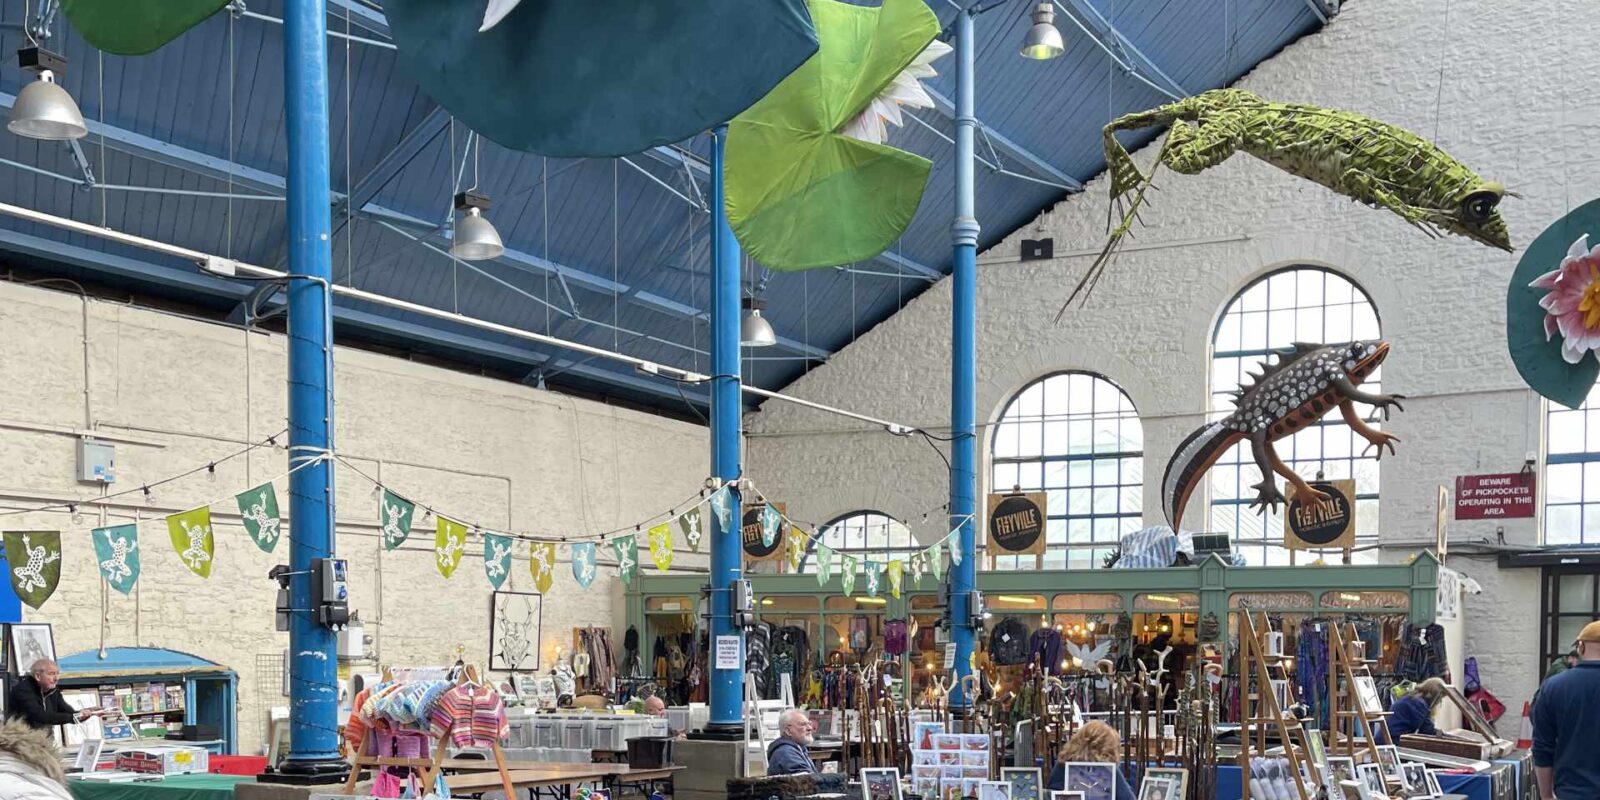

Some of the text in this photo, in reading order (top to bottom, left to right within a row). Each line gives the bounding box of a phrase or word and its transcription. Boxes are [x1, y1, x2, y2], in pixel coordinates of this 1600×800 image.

[1479, 478, 1512, 486] BEWARE
[1462, 487, 1529, 497] OF PICKPOCKETS
[1458, 496, 1533, 506] OPERATING IN THIS
